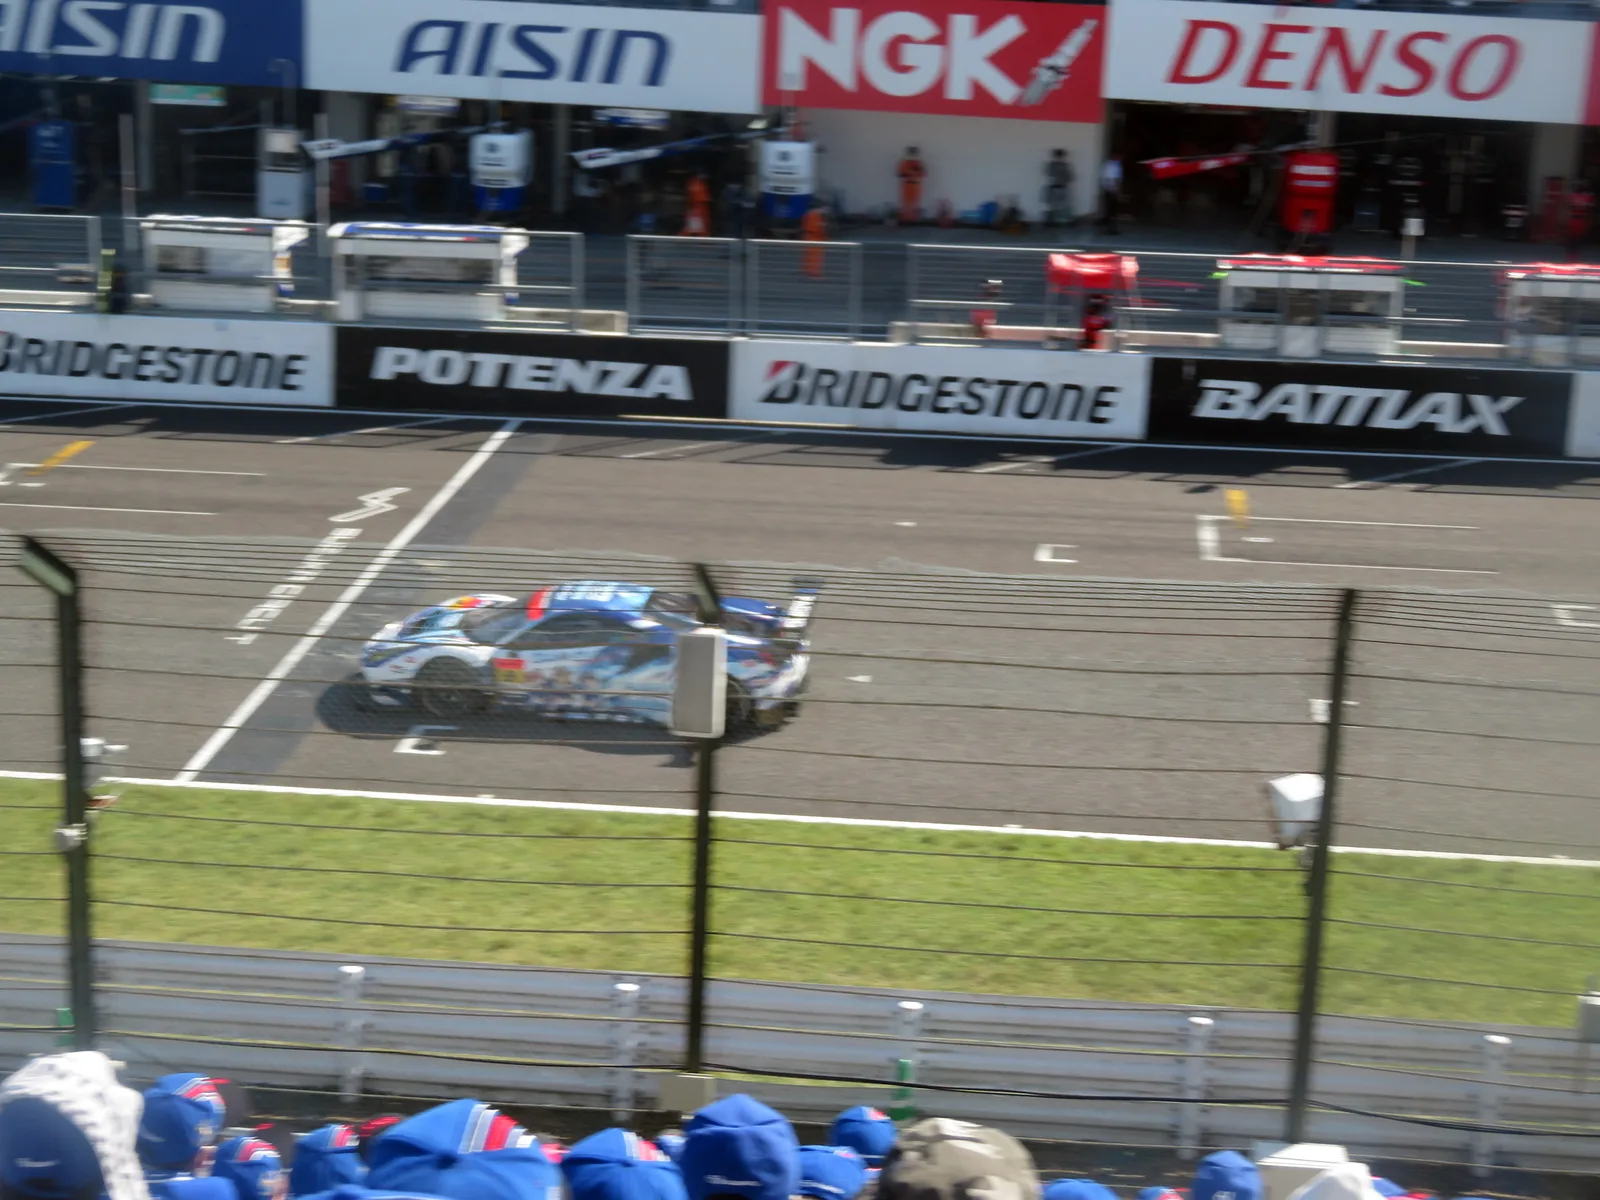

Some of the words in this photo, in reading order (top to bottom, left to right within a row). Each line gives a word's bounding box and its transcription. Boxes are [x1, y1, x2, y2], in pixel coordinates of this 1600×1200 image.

[393, 18, 674, 87] AISIN
[777, 5, 1028, 104] NGK
[1166, 18, 1526, 103] DENSO
[370, 345, 694, 402] POTENZA
[759, 360, 1122, 425] BRIDGESTONE
[1190, 379, 1527, 437] BATTLAX
[223, 584, 307, 645] CIRCUT
